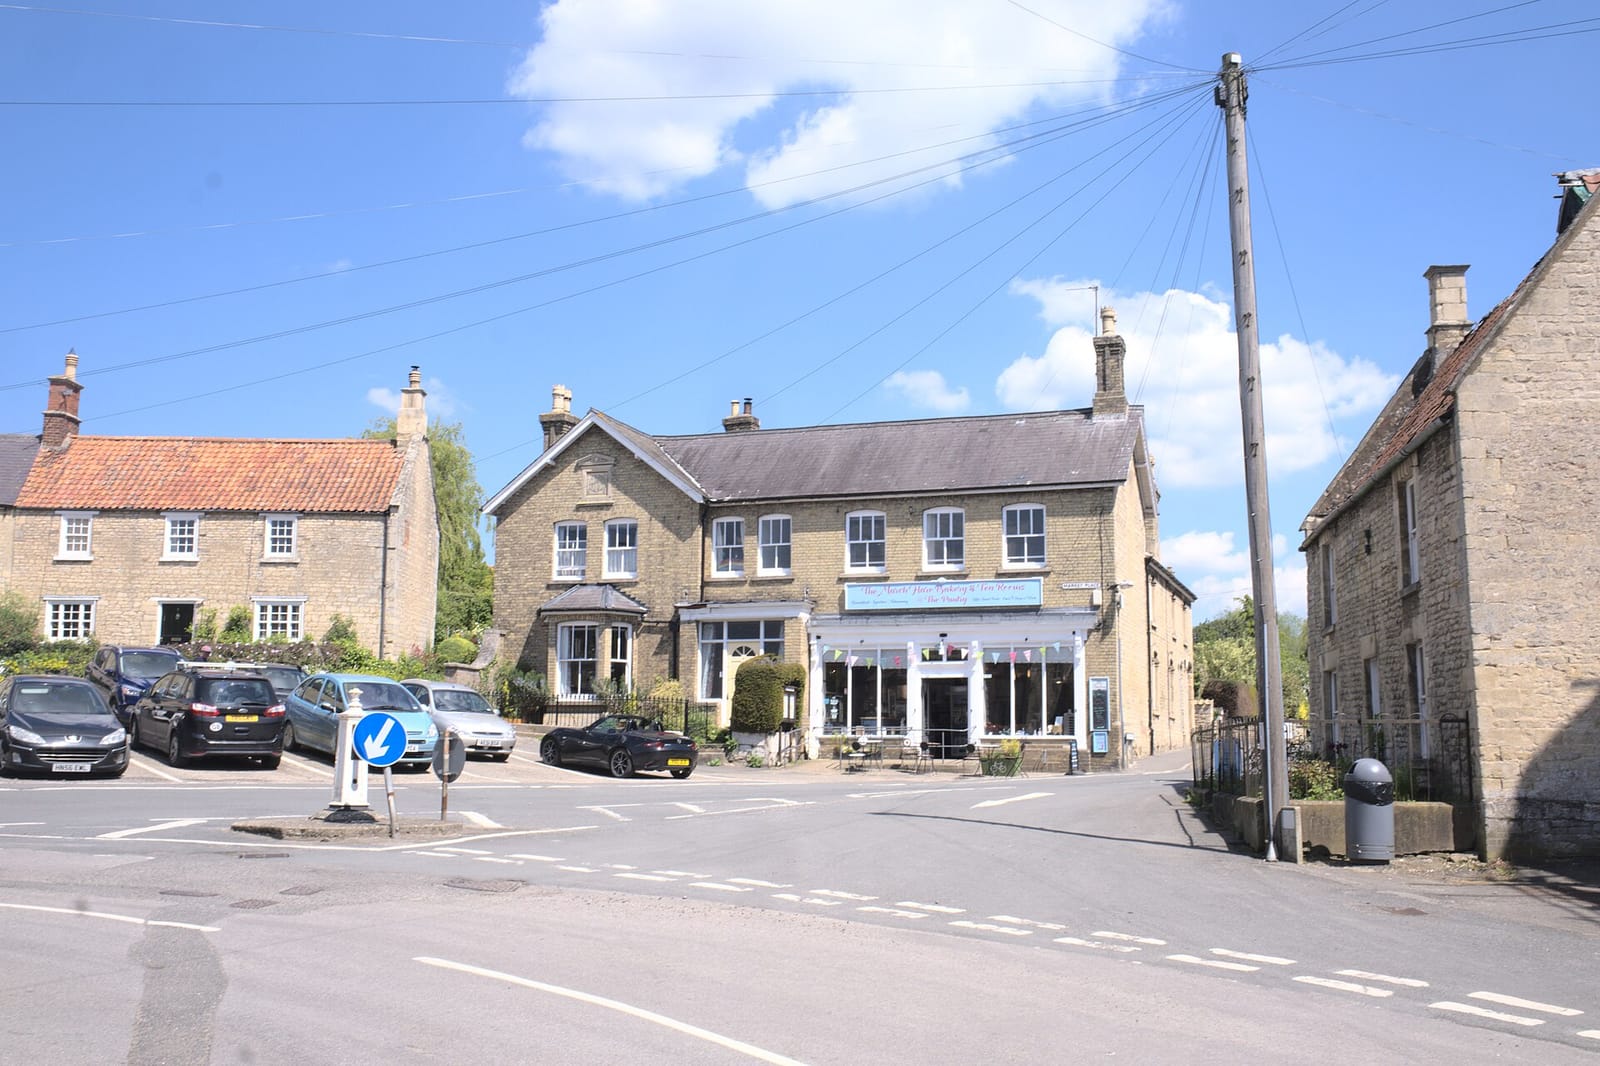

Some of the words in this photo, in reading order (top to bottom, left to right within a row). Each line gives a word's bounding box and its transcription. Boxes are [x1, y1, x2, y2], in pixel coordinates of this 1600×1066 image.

[860, 585, 877, 596] The
[877, 585, 912, 597] March
[912, 585, 933, 596] Hare
[935, 583, 968, 595] Bakery
[968, 584, 975, 592] &
[976, 582, 995, 591] Tea
[995, 582, 1025, 591] Rooms
[925, 595, 938, 603] The
[940, 595, 968, 605] Pantry
